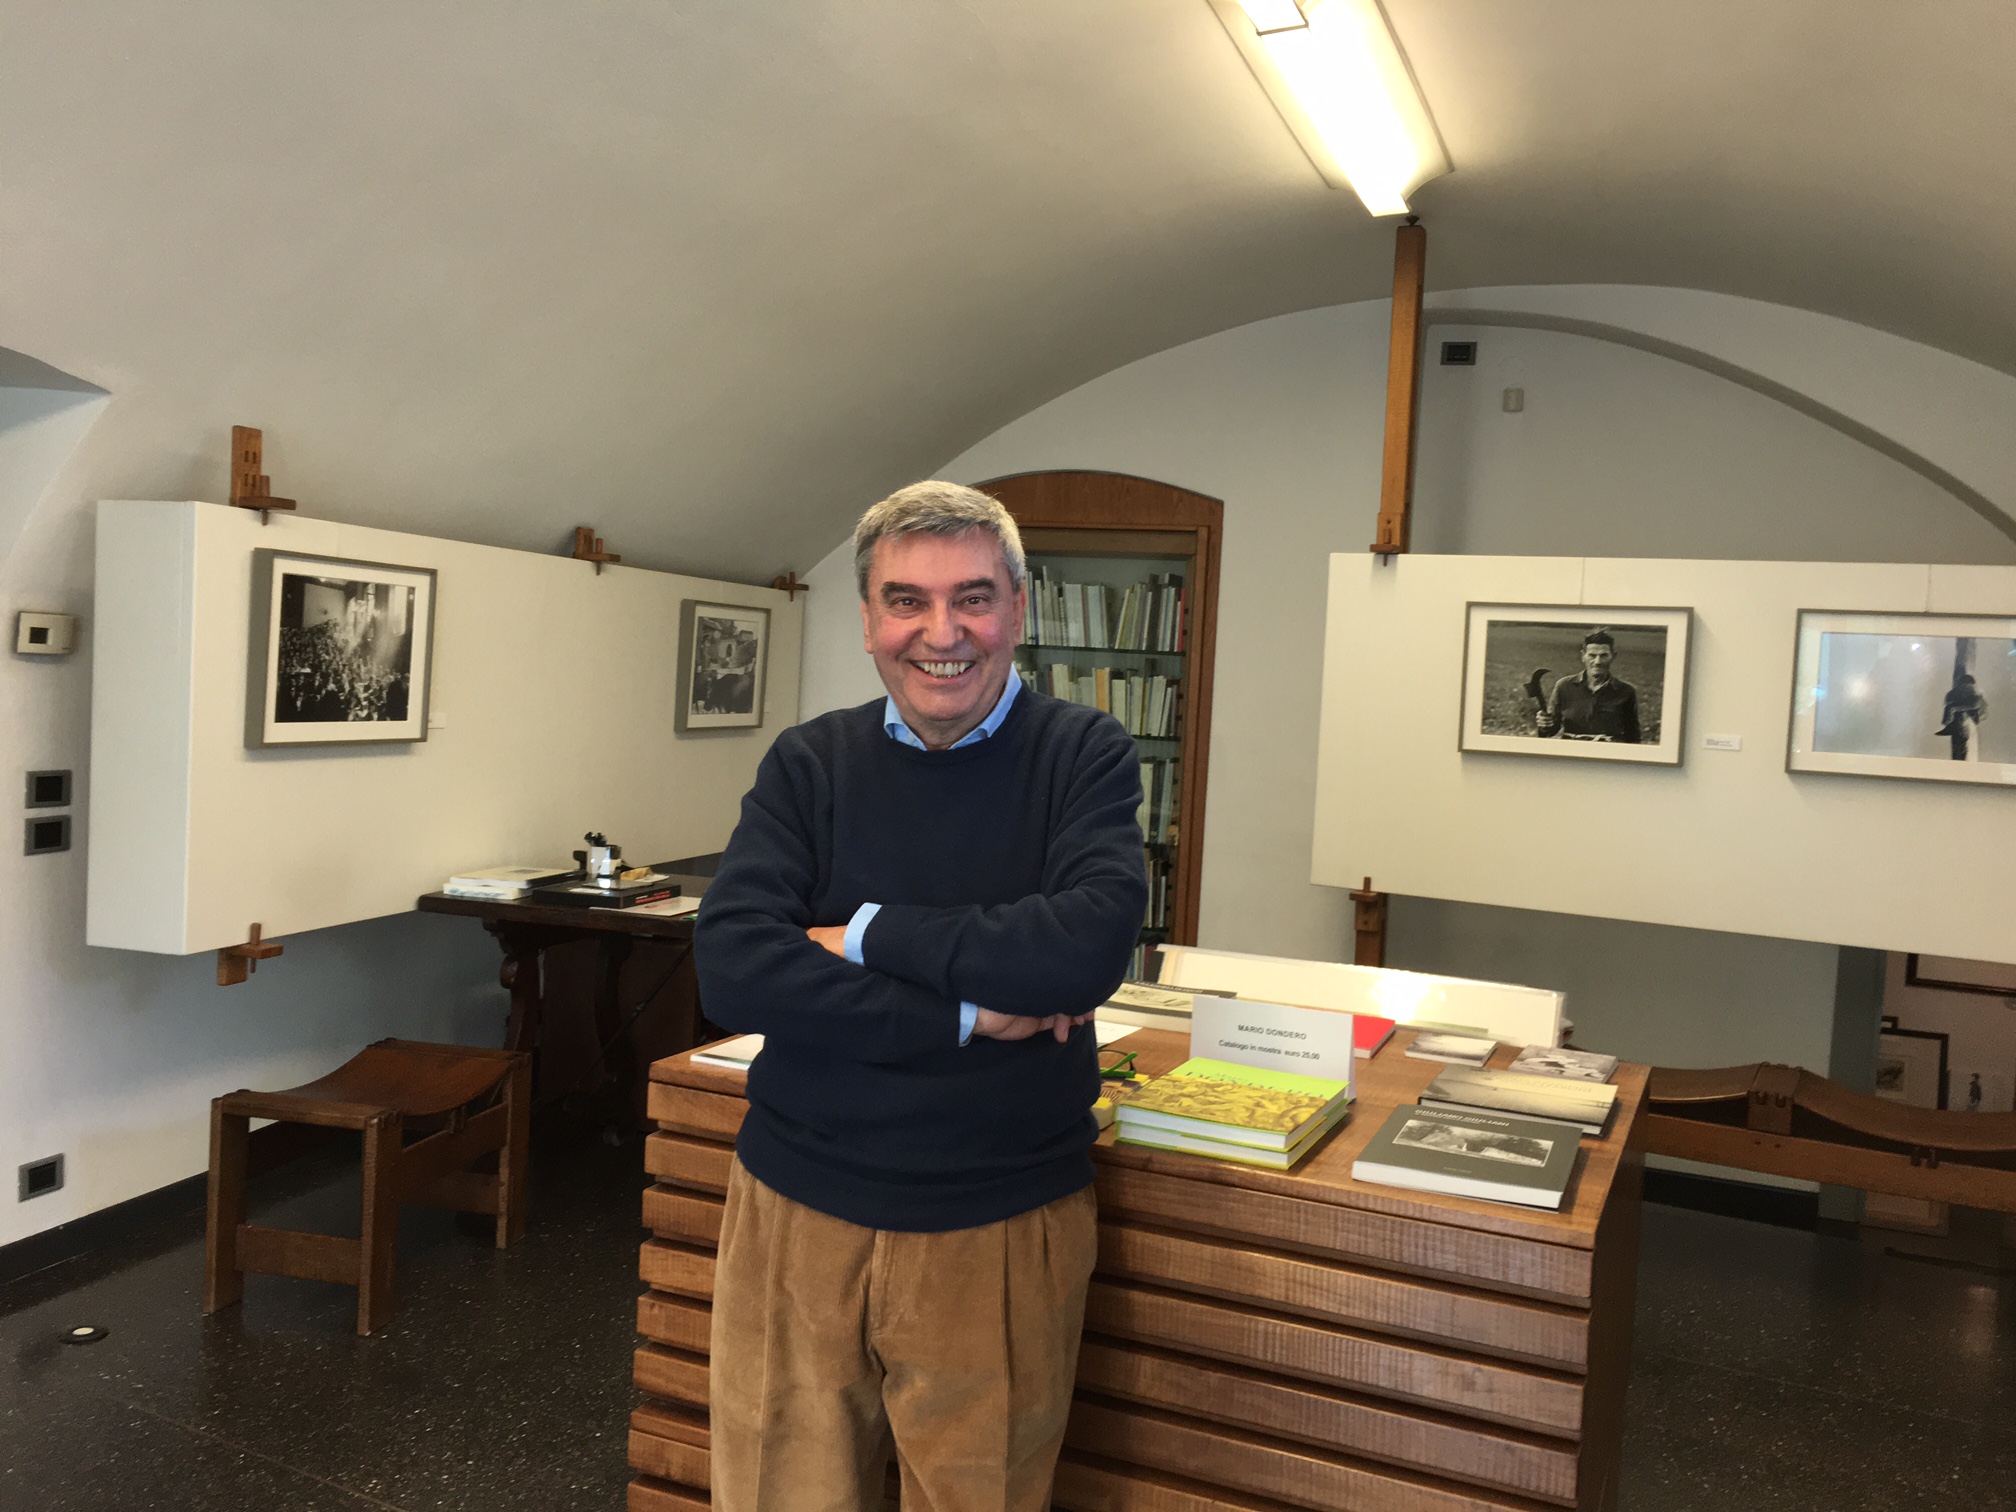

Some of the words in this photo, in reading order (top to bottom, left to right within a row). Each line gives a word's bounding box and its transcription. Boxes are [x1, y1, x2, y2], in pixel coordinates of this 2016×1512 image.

[1238, 1024, 1264, 1034] MARIO
[1266, 1028, 1307, 1040] DONDERO
[1219, 1039, 1249, 1050] Catalogo
[1258, 1045, 1282, 1055] mostra
